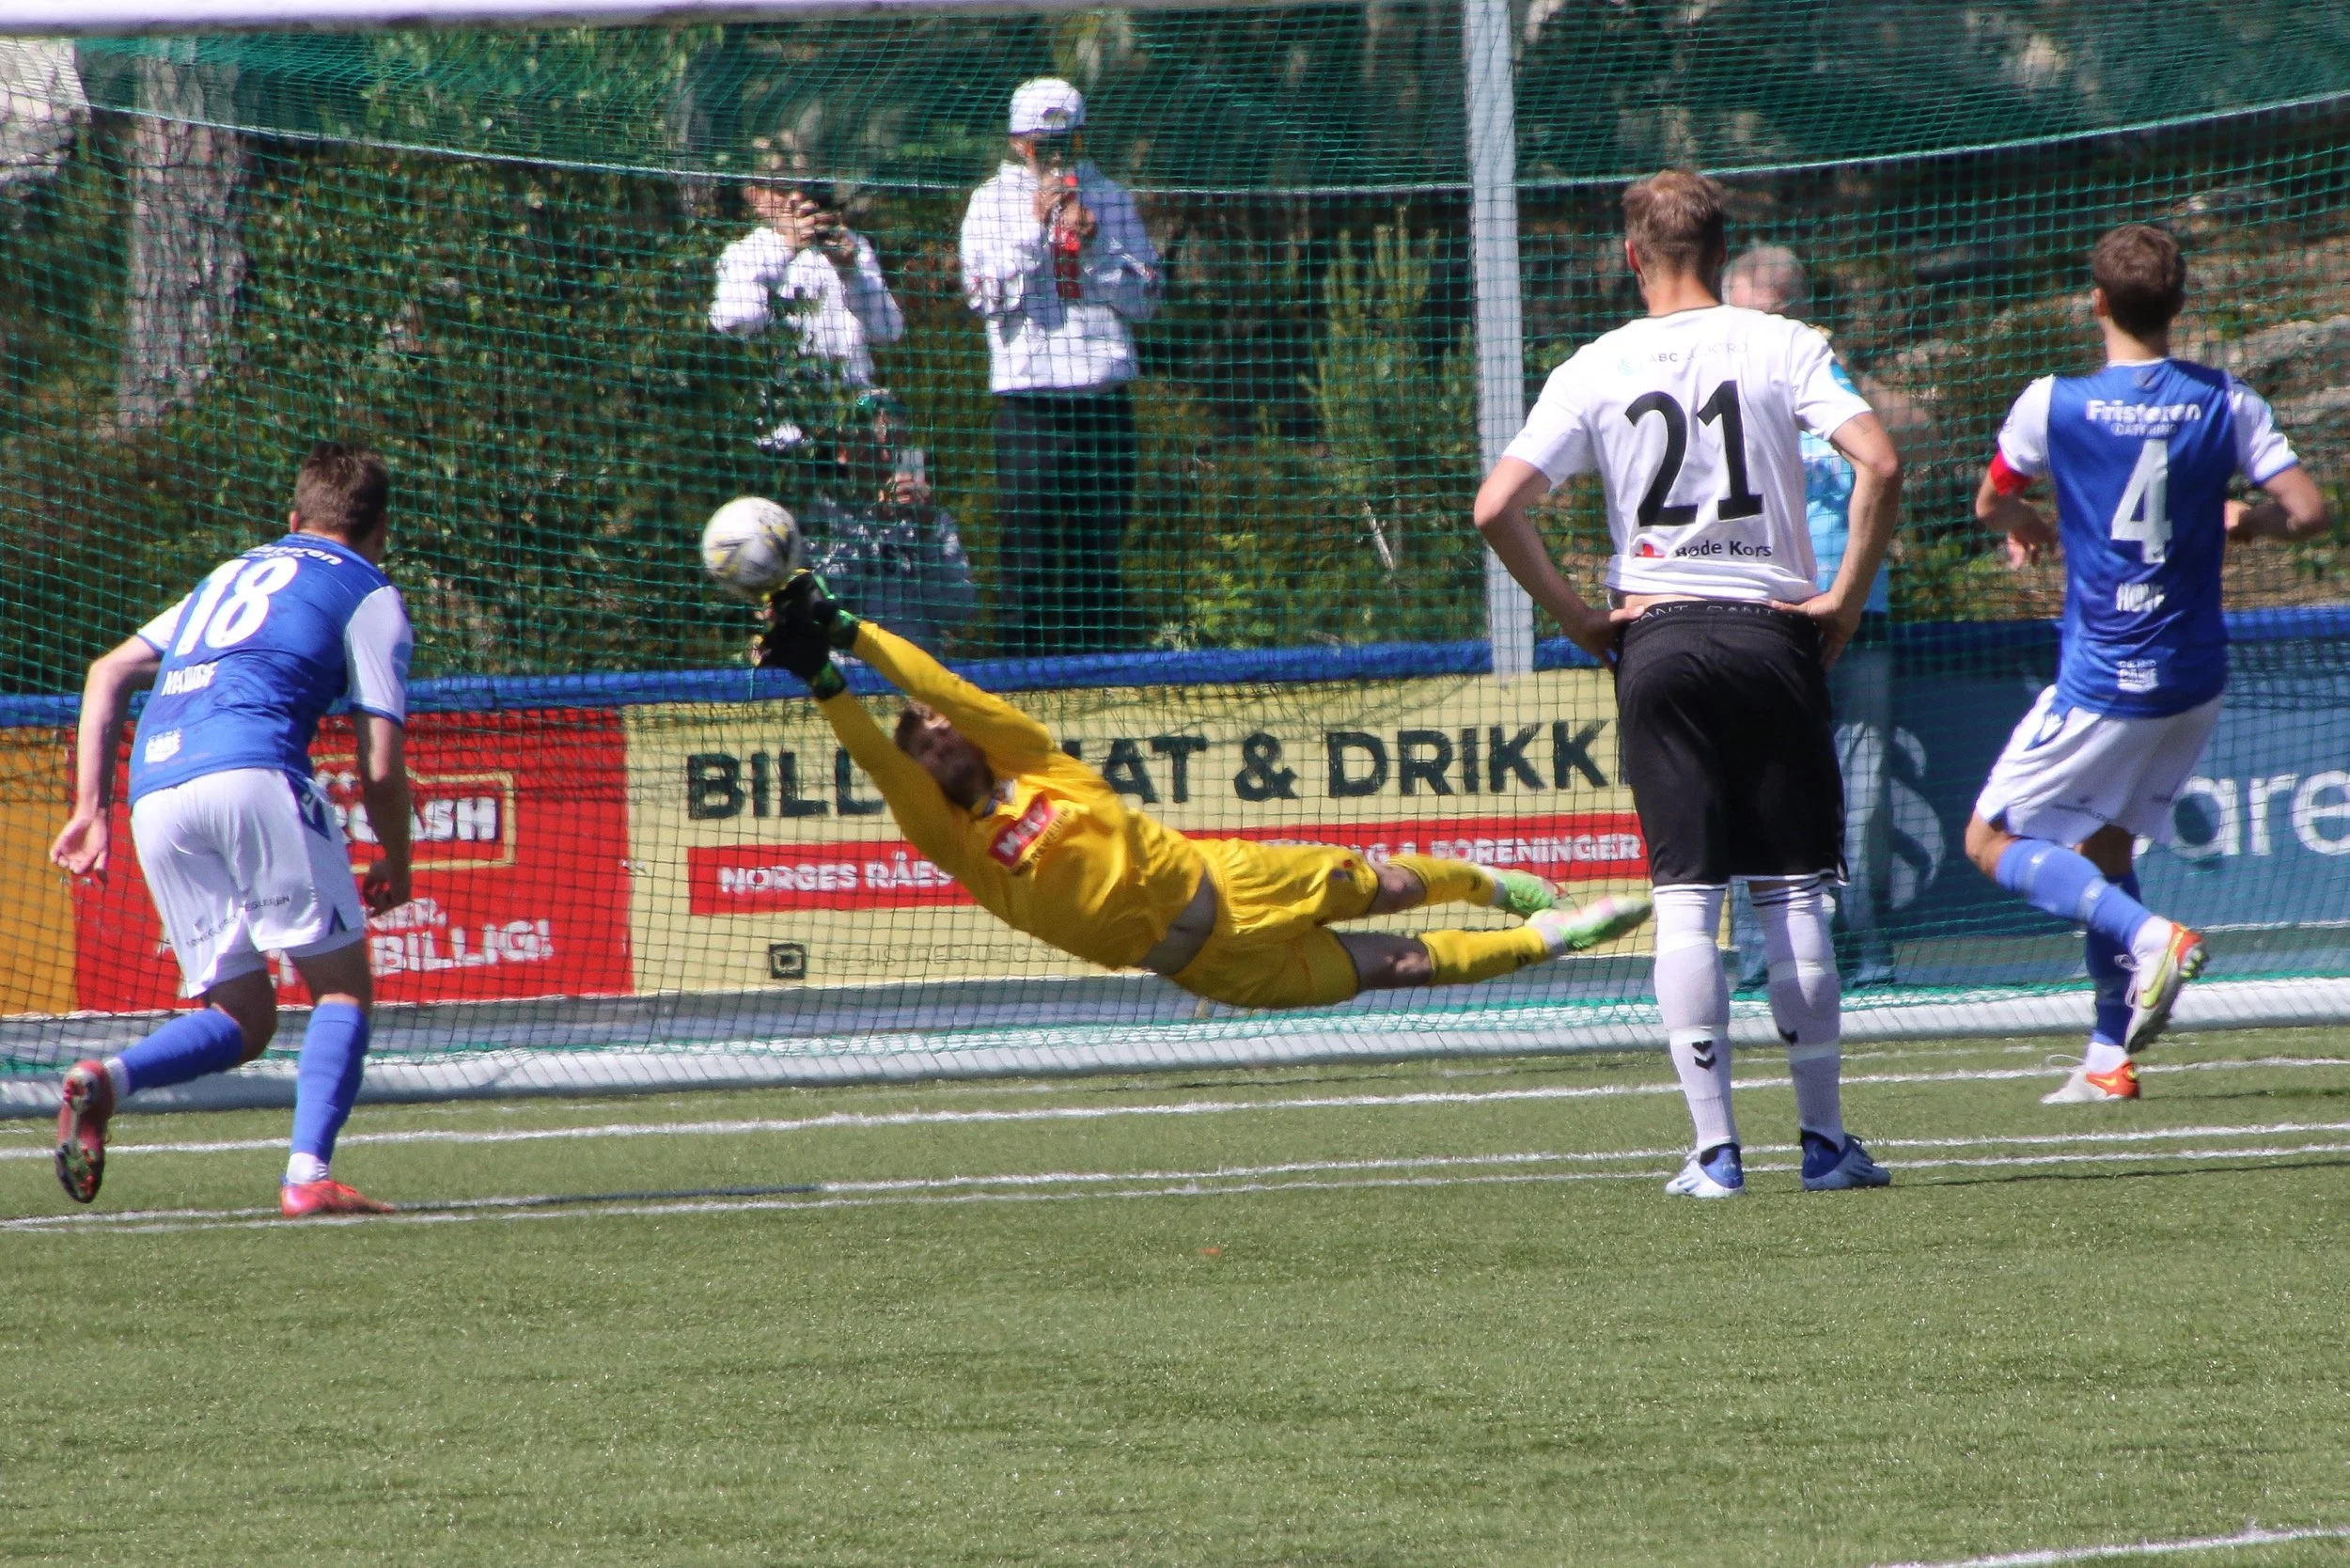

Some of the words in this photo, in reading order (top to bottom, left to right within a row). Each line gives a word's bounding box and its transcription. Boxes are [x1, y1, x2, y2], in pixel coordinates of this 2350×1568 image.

[1624, 379, 1763, 527] 21
[2109, 439, 2173, 564] 4
[1729, 541, 1773, 557] Kors
[174, 556, 299, 657] 18
[687, 747, 886, 820] BILL
[1063, 735, 1210, 804] AT
[1233, 732, 1299, 801] &
[1326, 720, 1631, 798] DRIKK
[719, 863, 859, 894] NORGES
[864, 850, 955, 889] RÅES
[1430, 833, 1642, 866] FORENINGER
[370, 917, 555, 978] BILLIG!
